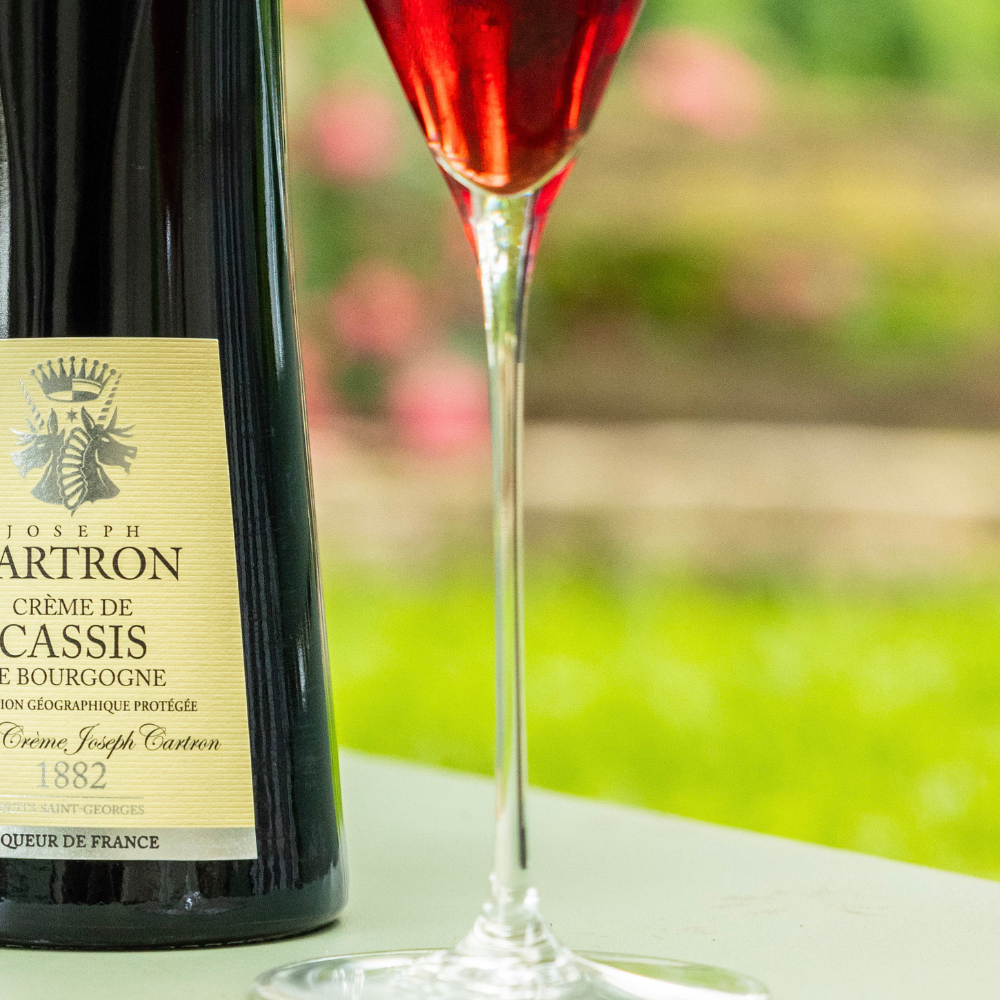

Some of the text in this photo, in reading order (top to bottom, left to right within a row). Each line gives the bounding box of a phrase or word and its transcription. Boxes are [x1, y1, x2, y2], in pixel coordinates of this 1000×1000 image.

[6, 525, 140, 539] JOSEPH
[12, 594, 133, 616] CRÈME DE
[0, 623, 147, 659] CASSIS
[17, 668, 167, 687] BOURGOGNE
[27, 697, 130, 714] GÉOGRAPHIQUE
[134, 698, 198, 712] PROTÉGÉE
[64, 723, 137, 759] Joseph
[139, 723, 222, 751] Cartron
[37, 761, 107, 789] 1882
[41, 803, 145, 815] SAINT-GEORGES
[63, 835, 87, 849] DE
[91, 835, 159, 850] FRANCE
